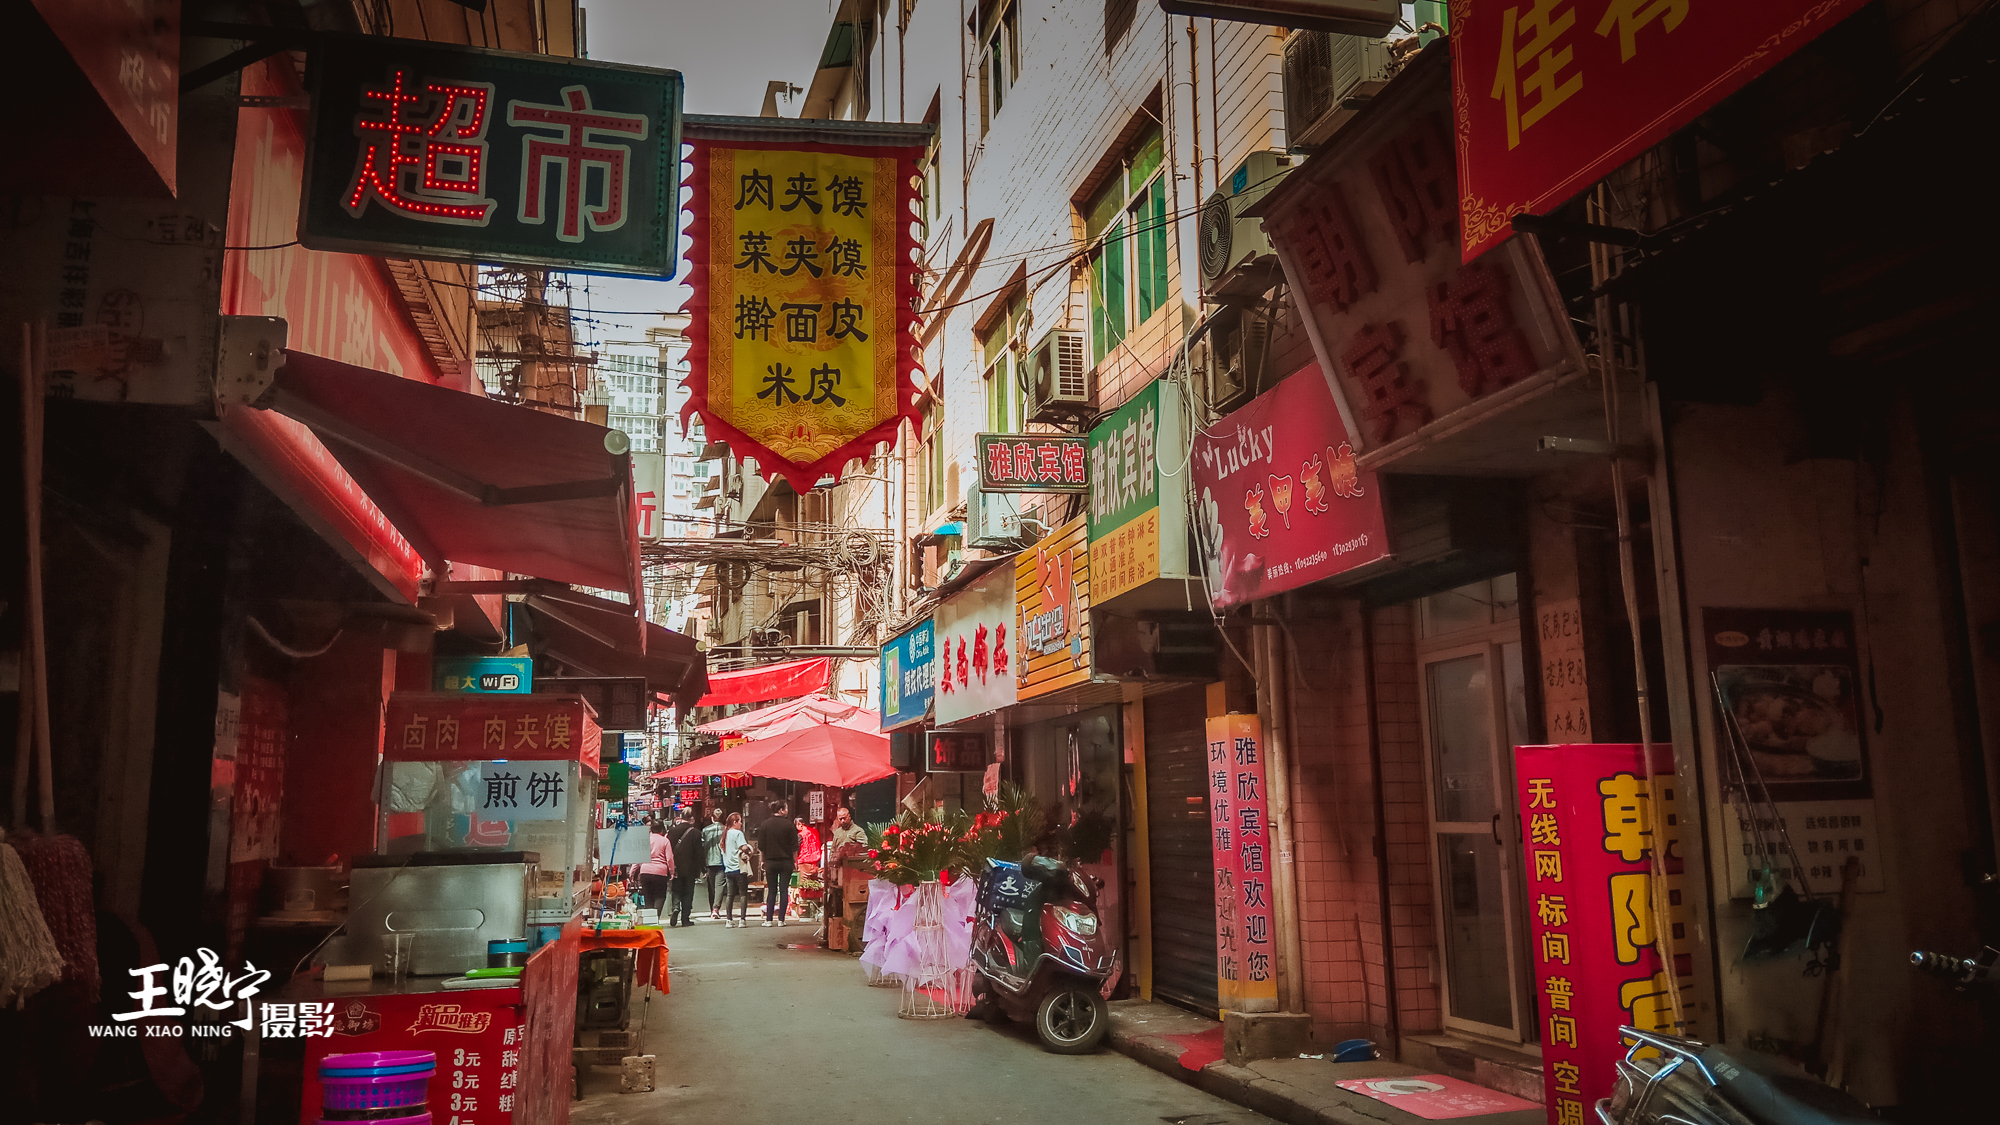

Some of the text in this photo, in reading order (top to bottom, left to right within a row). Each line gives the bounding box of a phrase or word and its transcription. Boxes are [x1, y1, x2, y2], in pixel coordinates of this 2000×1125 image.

[343, 68, 649, 242] 超市
[734, 169, 867, 219] 肉夹馍
[734, 230, 866, 280] 菜夹馍
[734, 295, 868, 343] 擀面皮
[1341, 262, 1537, 443] 宾馆
[757, 362, 846, 407] 米皮
[988, 442, 1085, 482] 雅欣宾馆
[1092, 401, 1155, 526] 雅欣宾馆
[1214, 424, 1273, 480] Lucky
[402, 713, 572, 750] 卤肉 肉夹馍
[483, 771, 565, 809] 煎饼
[1210, 741, 1232, 852] 环境优雅
[1527, 777, 1563, 883] 无线网
[1235, 737, 1269, 982] 雅欣宾馆欢迎您
[1537, 893, 1570, 966] 标间
[418, 1004, 491, 1030] 新品推荐
[1544, 976, 1578, 1050] 普间
[452, 1070, 480, 1089] 3元
[453, 1048, 481, 1067] 3元
[450, 1093, 478, 1112] 3元
